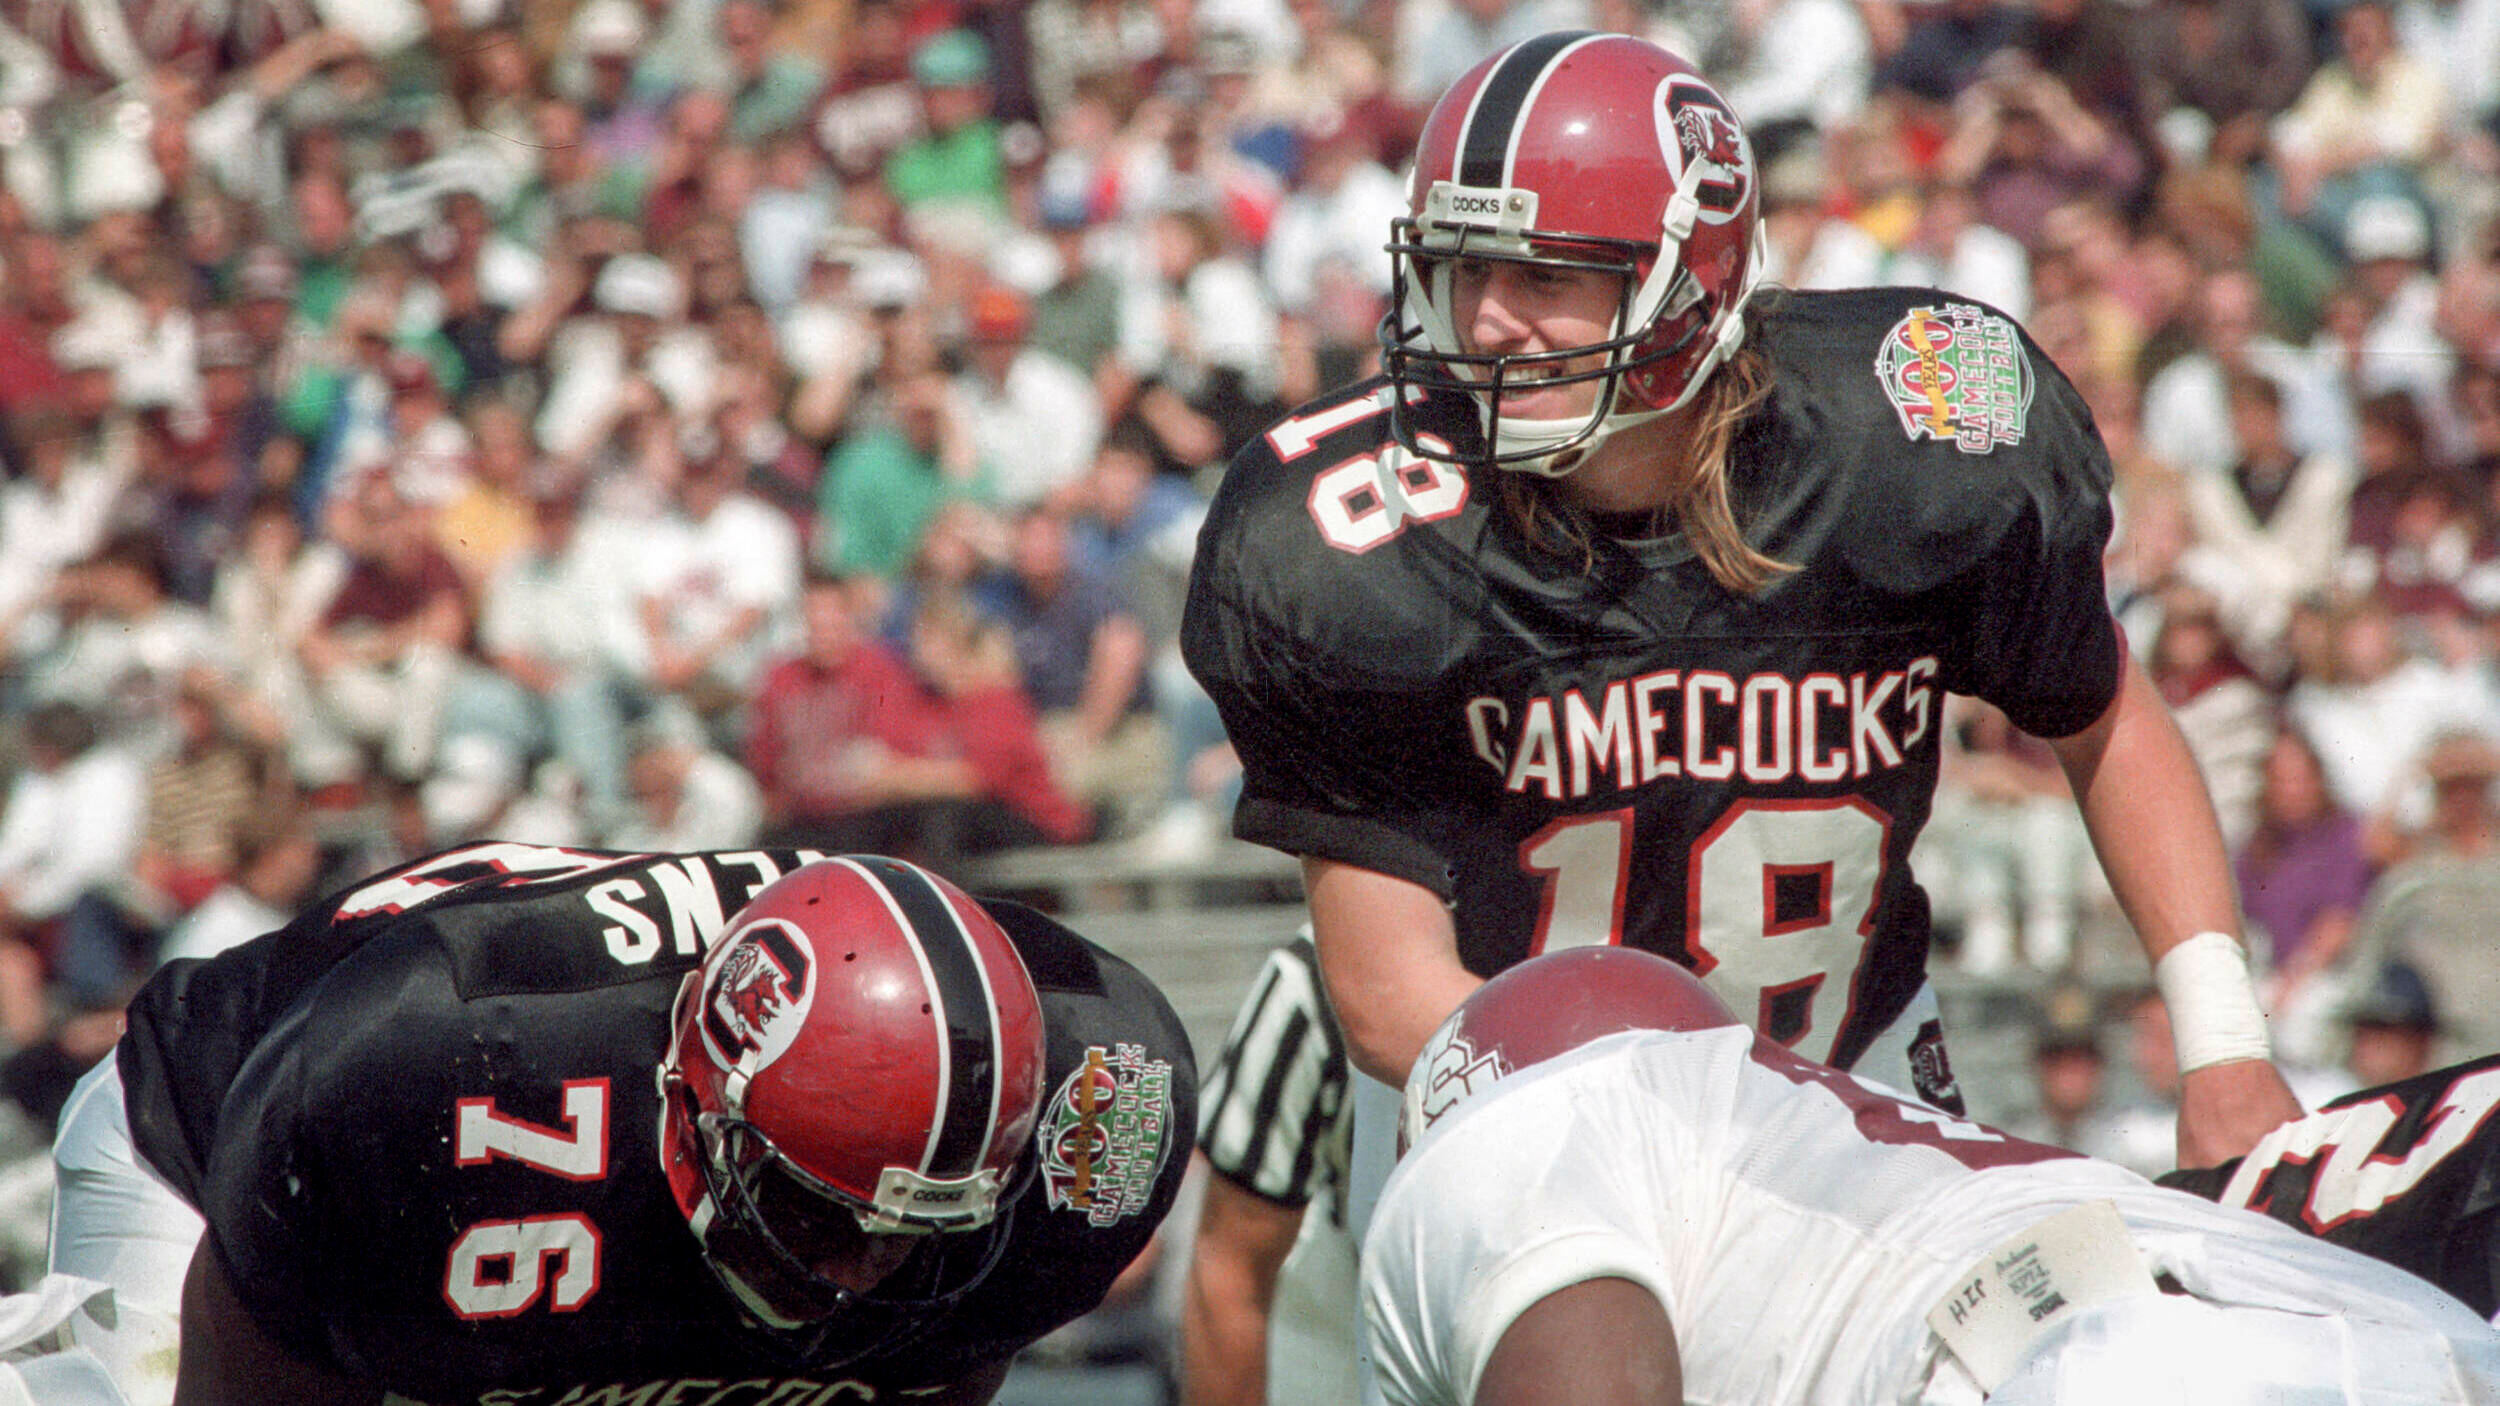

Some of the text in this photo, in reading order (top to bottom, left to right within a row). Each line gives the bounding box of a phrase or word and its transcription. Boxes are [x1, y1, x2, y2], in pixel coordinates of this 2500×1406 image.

[1452, 195, 1501, 214] COCKS
[1896, 318, 1960, 432] 100
[1920, 347, 1939, 390] YEARS
[1953, 304, 1991, 451] GAMECOCK
[1984, 317, 2019, 443] FOOTBALL
[1264, 381, 1470, 556] 18
[1466, 655, 1938, 800] GAMECOCKS
[1517, 795, 1894, 1070] 18
[442, 1077, 611, 1320] 76
[1051, 1067, 1118, 1203] 100
[1094, 1044, 1143, 1223] GAMECOCK
